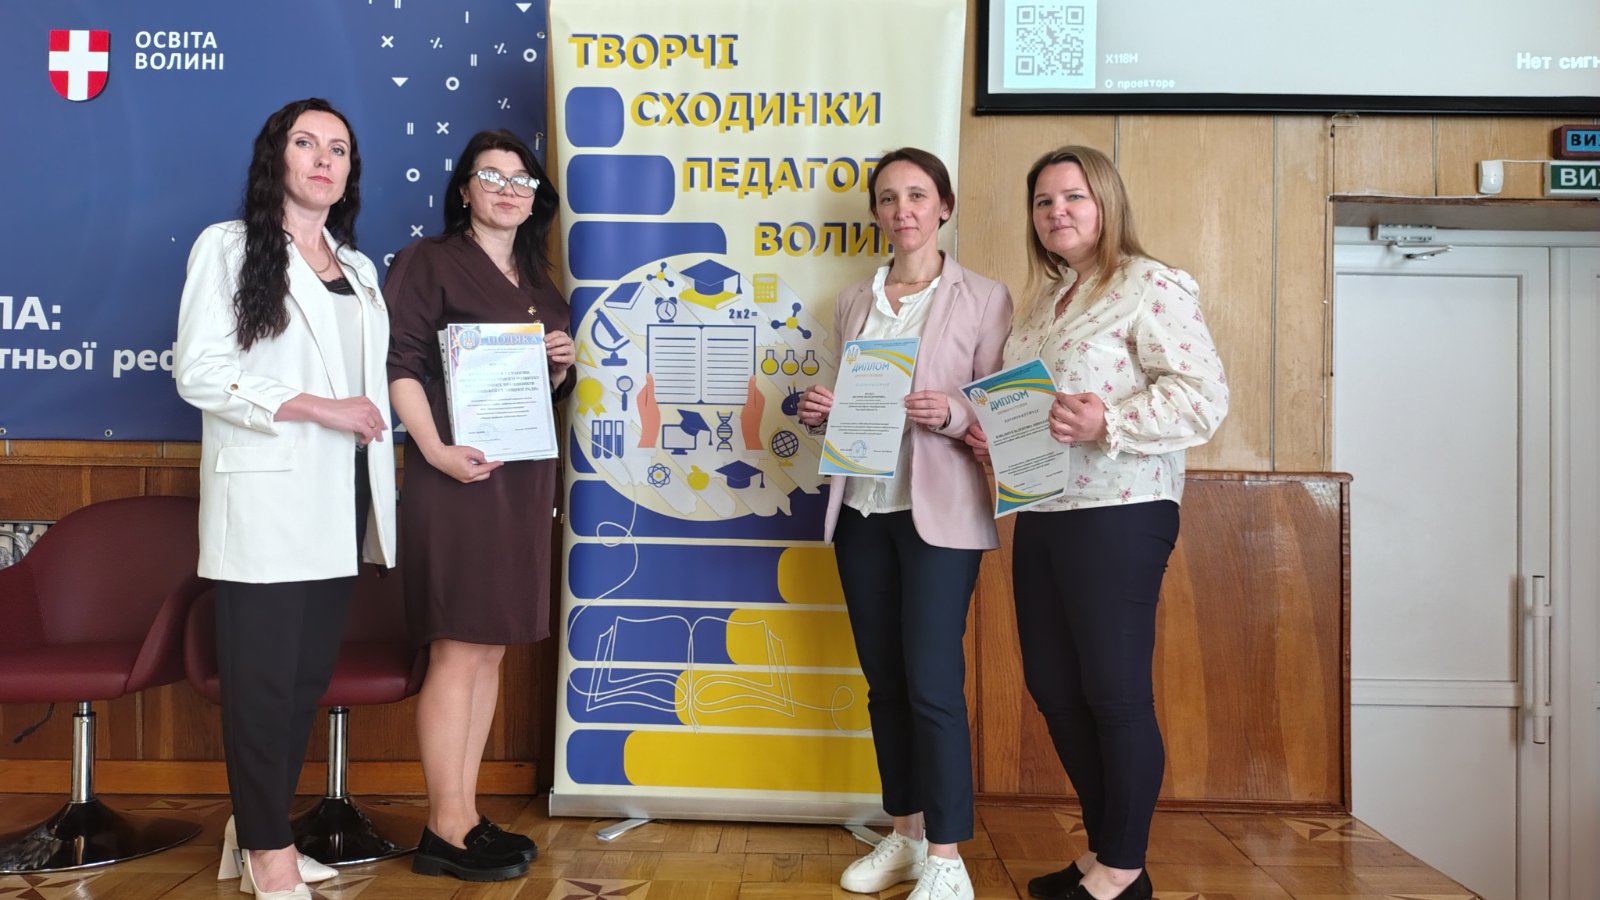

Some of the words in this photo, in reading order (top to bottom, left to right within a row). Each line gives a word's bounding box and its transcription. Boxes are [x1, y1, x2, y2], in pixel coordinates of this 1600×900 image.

[135, 31, 217, 49] ОСВІТА
[568, 33, 739, 70] ТВОРЧІ
[135, 52, 224, 70] ВОЛИНІ
[1516, 52, 1552, 70] Нет
[629, 91, 882, 134] СХОДИНКИ
[1570, 133, 1600, 147] ВИ
[1560, 168, 1600, 187] ВИ
[851, 361, 890, 373] ДИПЛОМ
[990, 389, 1029, 413] ДИПЛОМ
